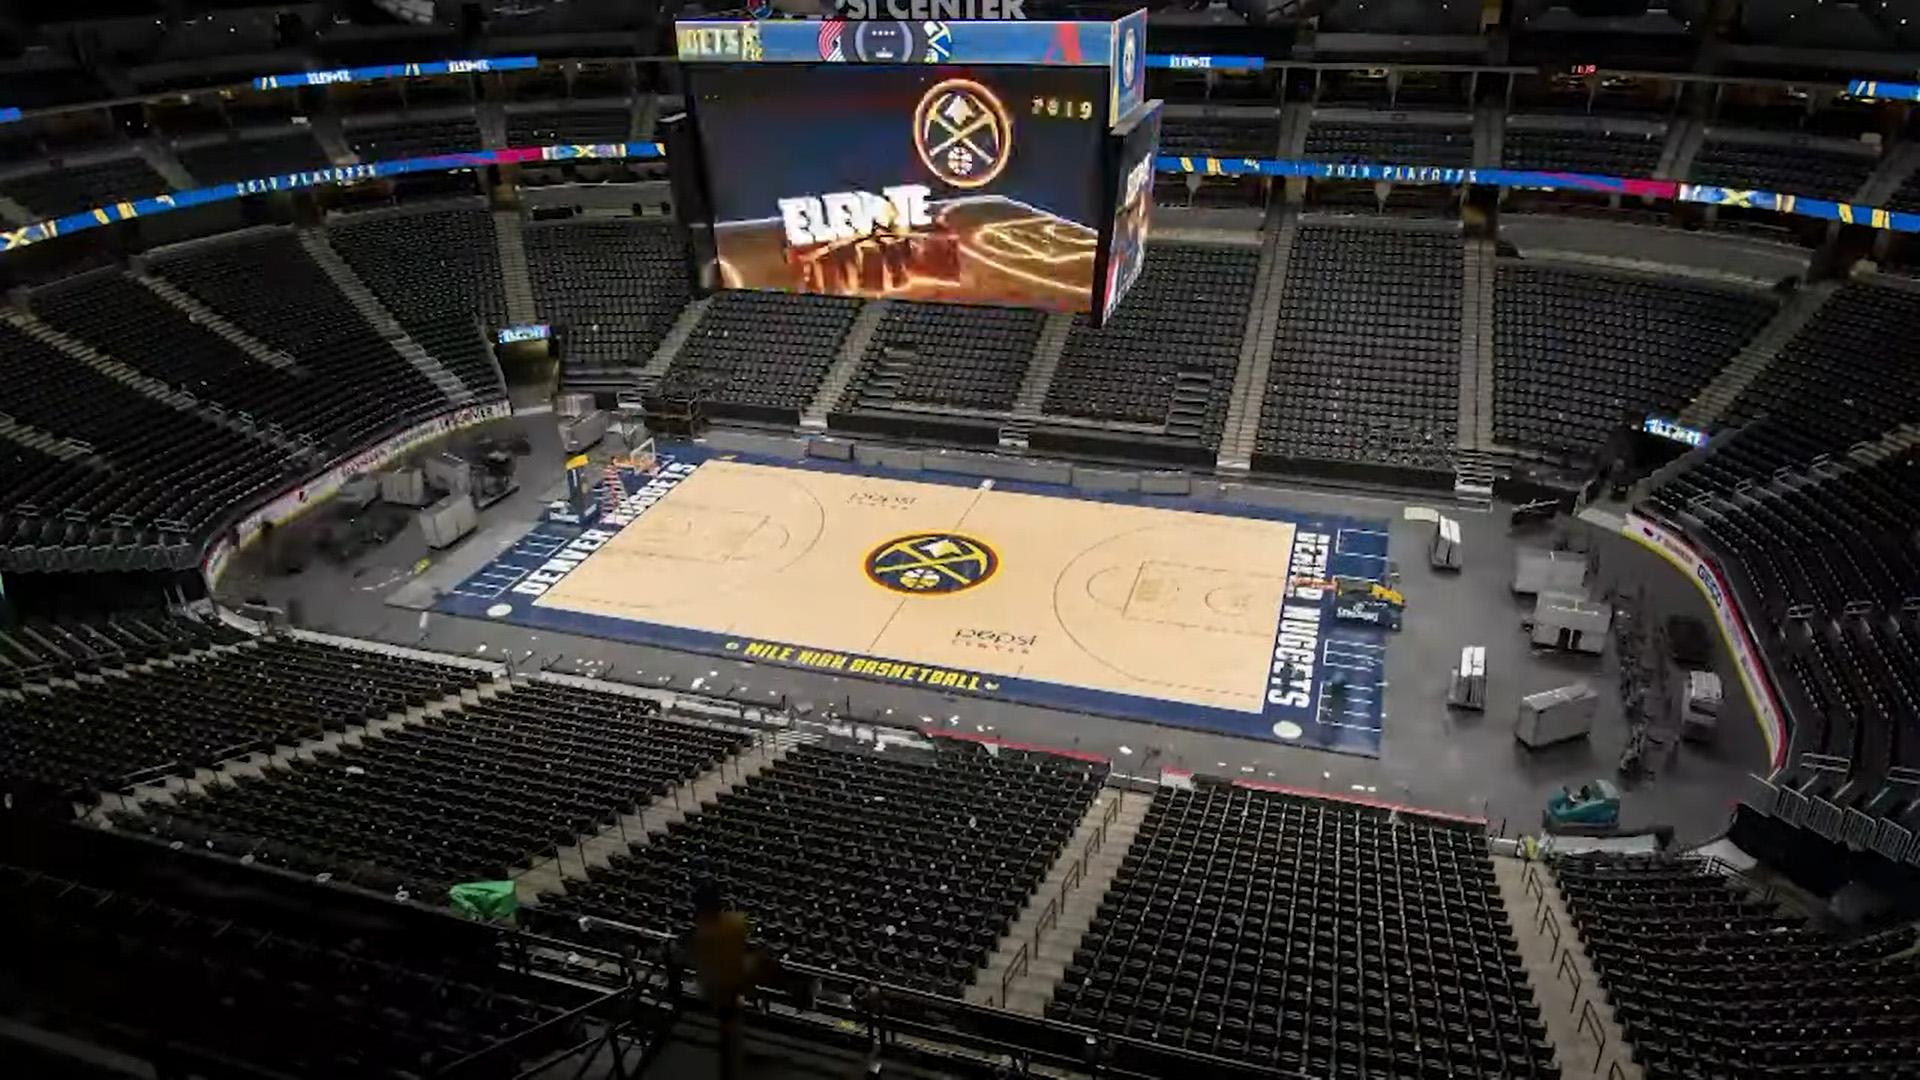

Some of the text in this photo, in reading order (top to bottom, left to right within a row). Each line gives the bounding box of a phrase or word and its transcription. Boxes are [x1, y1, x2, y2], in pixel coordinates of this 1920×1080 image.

[511, 528, 618, 596] DENVER
[744, 641, 794, 662] MILE
[849, 658, 981, 691] BASKETBALL
[955, 628, 1037, 647] pepsi
[1267, 605, 1322, 708] NUGGETS
